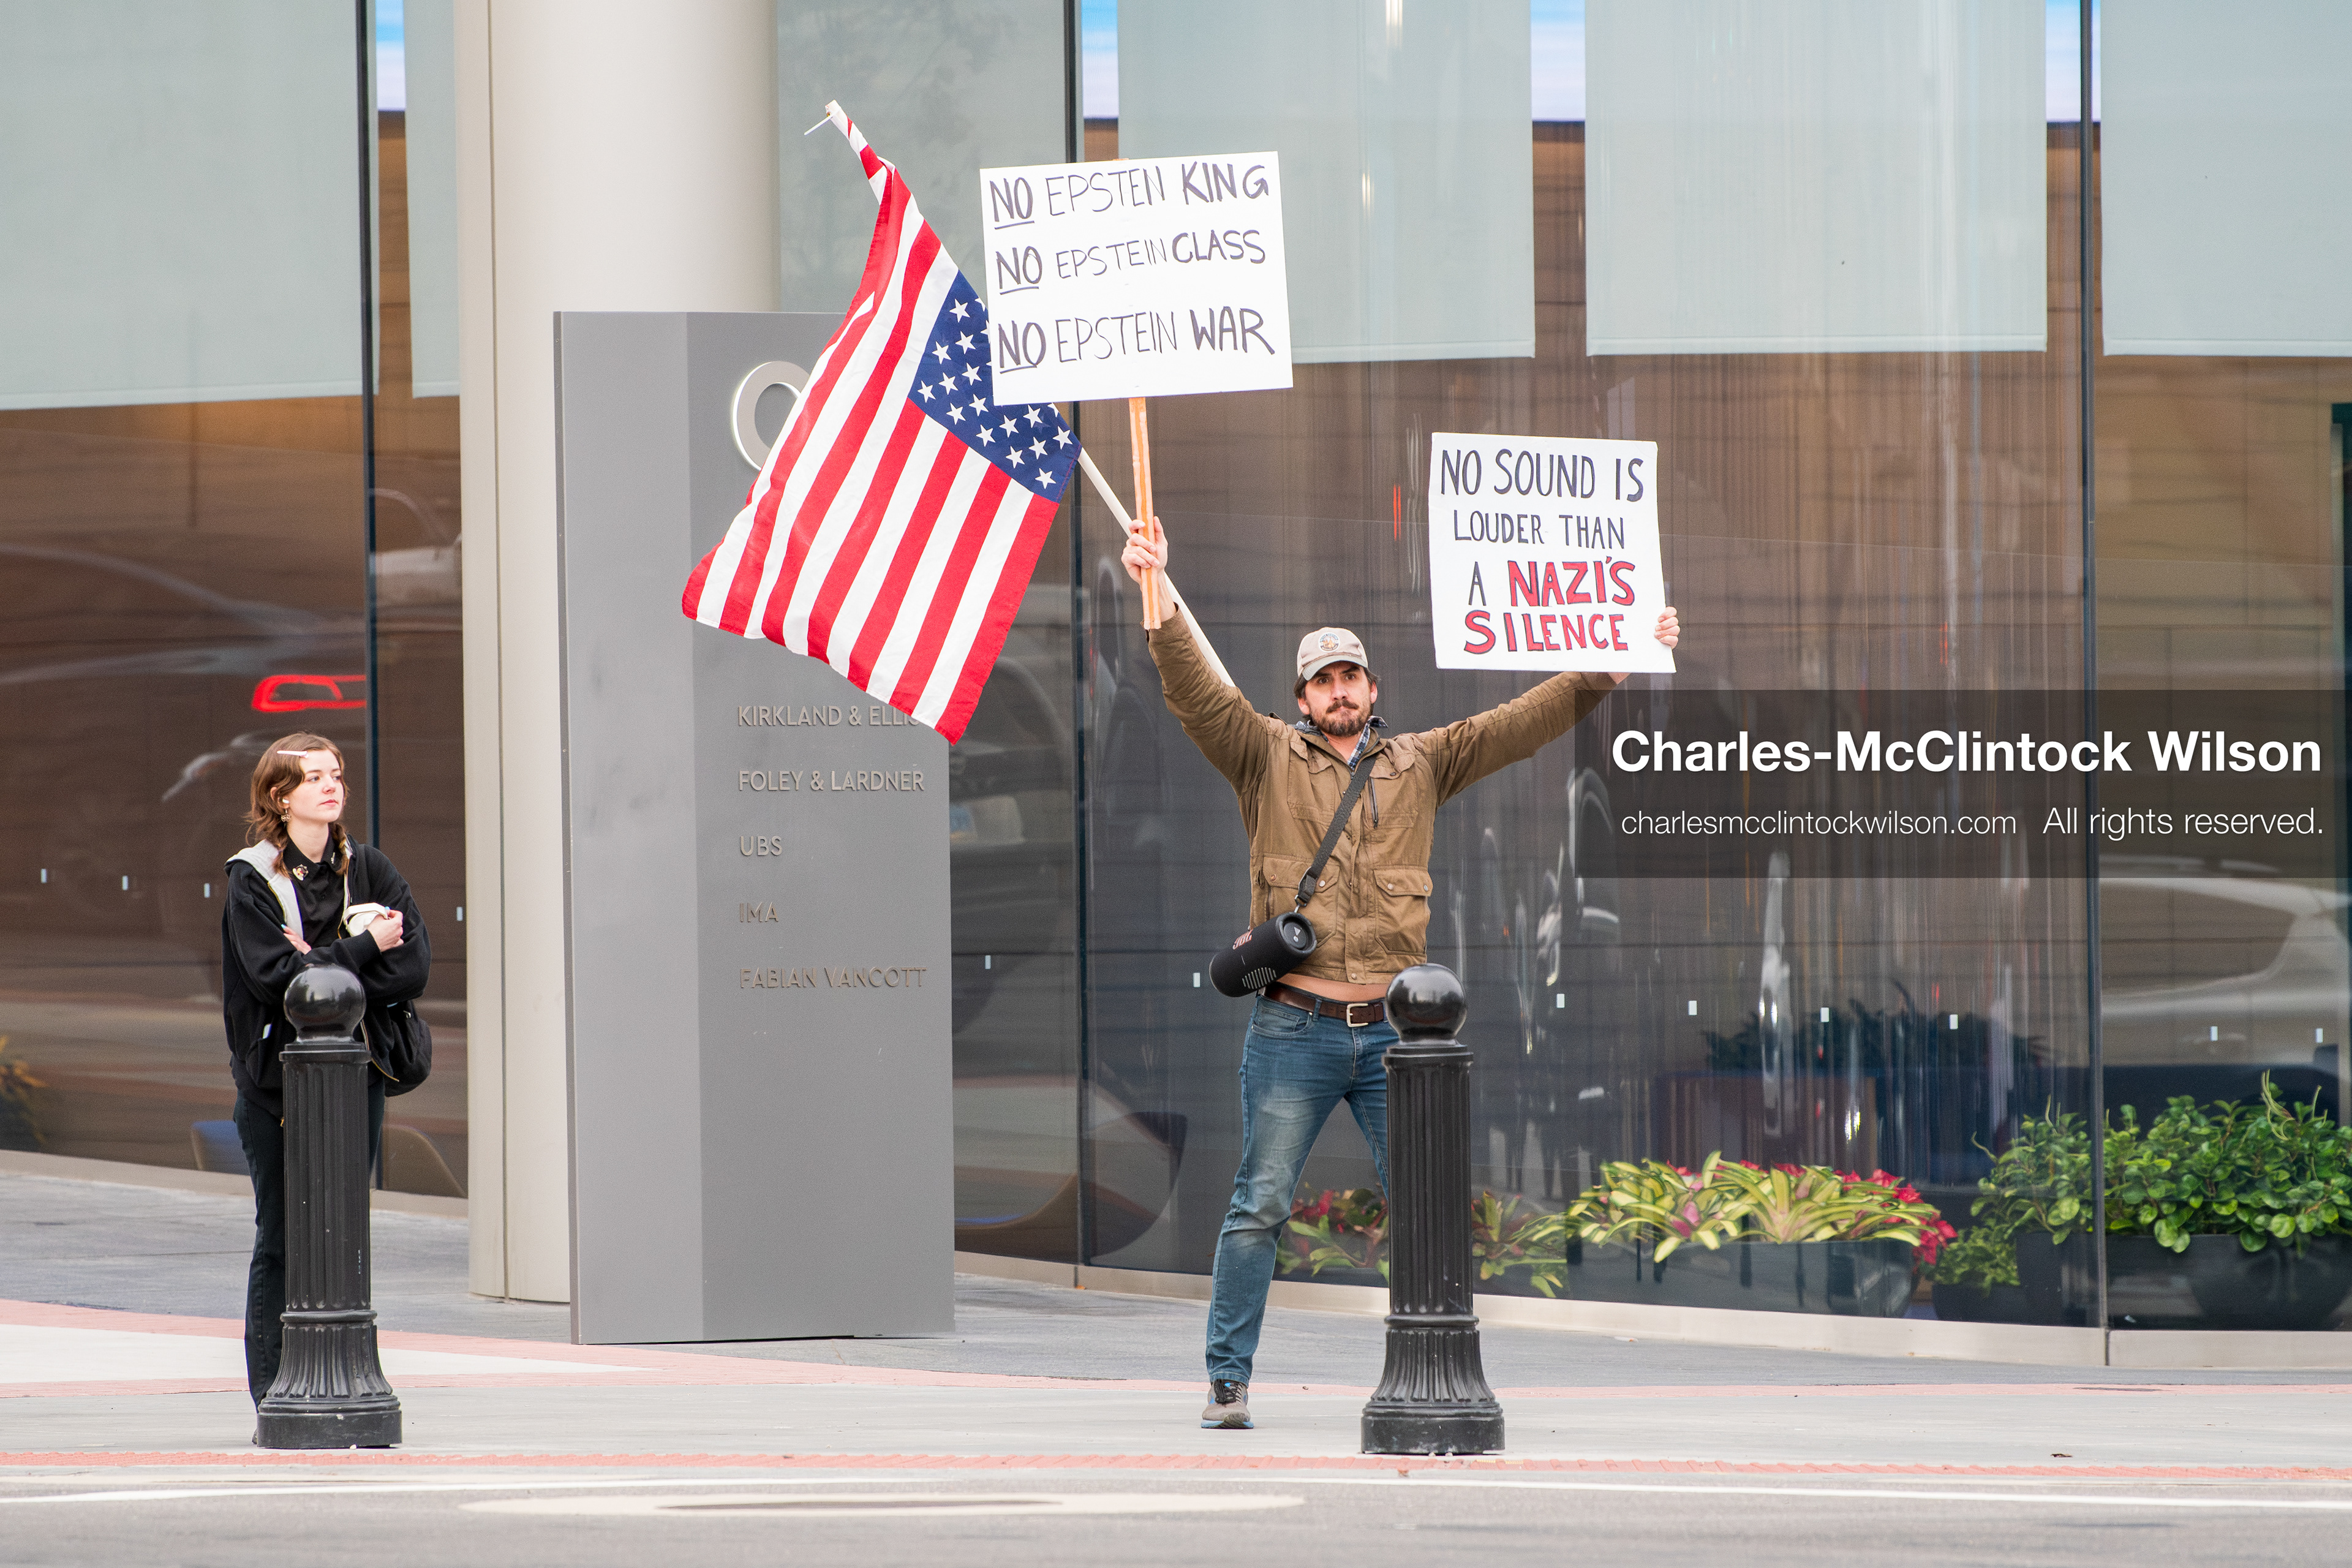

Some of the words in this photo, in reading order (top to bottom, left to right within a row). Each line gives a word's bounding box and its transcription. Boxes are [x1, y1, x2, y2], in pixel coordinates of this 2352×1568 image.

[990, 176, 1033, 222] NO
[1046, 165, 1165, 216] EPSTEN
[1182, 161, 1268, 205] KING
[996, 246, 1042, 289] NO
[1056, 238, 1167, 279] EPSTEIN
[1172, 230, 1265, 264] CLASS
[998, 320, 1046, 368] NO
[1055, 311, 1177, 363] EPSTEIN
[1189, 306, 1275, 355] WAR
[1441, 450, 1482, 496] NO
[1494, 448, 1596, 499] SOUND
[1616, 458, 1644, 502] IS
[1454, 510, 1545, 544] LOUDER
[1559, 514, 1624, 549] THAN
[1468, 561, 1486, 606] A
[1507, 556, 1635, 607] NAZI'S
[1464, 610, 1629, 655] SILENCE
[737, 706, 843, 726] KIRKLAND
[848, 706, 862, 726] &
[869, 705, 919, 726] ELLI
[739, 771, 804, 791] FOLEY
[810, 771, 824, 791] &
[831, 771, 924, 791] LARDNER
[740, 835, 783, 856] UBS
[739, 902, 778, 922] IMA
[740, 967, 817, 988] FABIAN
[824, 967, 927, 988] VANCOTT
